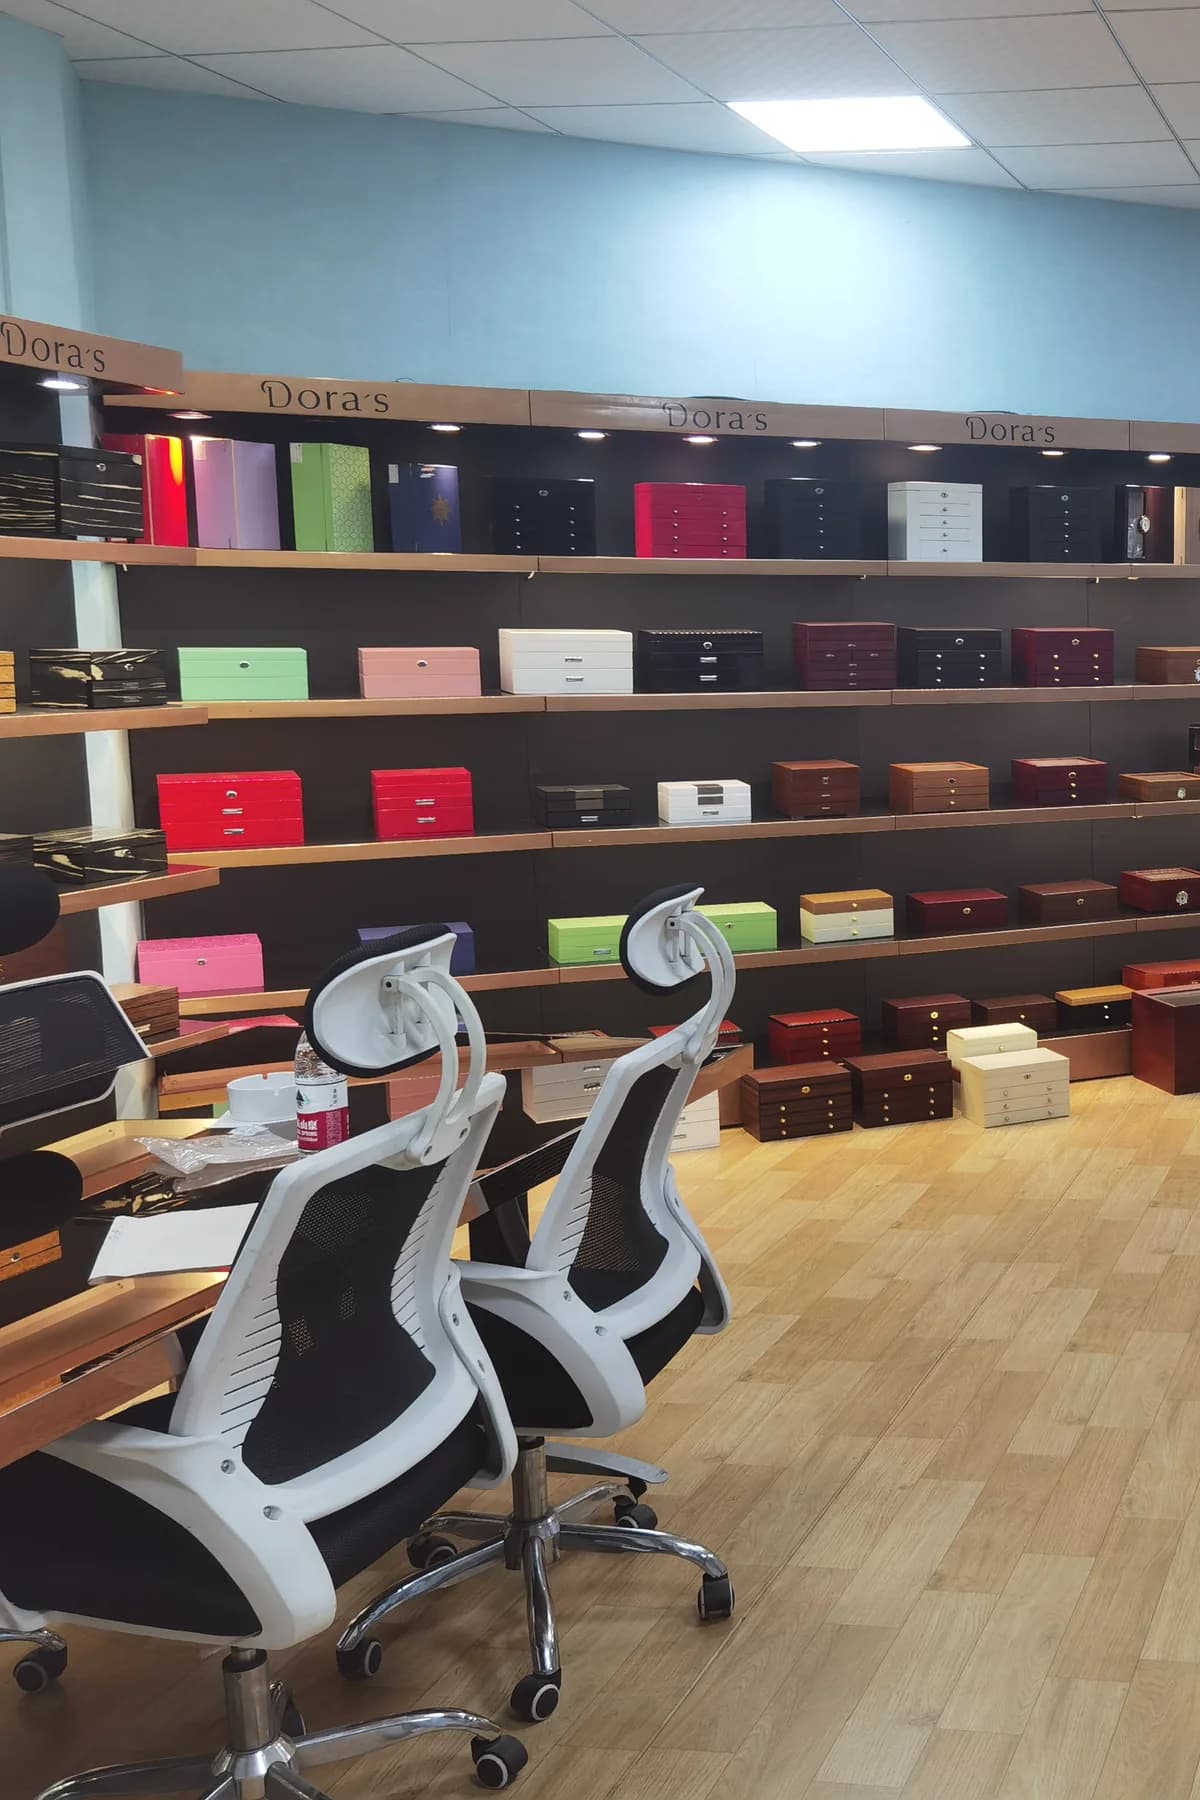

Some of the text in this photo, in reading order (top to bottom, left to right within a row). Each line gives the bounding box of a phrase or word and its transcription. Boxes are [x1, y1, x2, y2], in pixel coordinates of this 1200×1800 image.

[0, 321, 105, 373] Dora's
[261, 379, 390, 413] Dora's
[662, 402, 768, 431] Dora's
[965, 416, 1056, 444] Dora's
